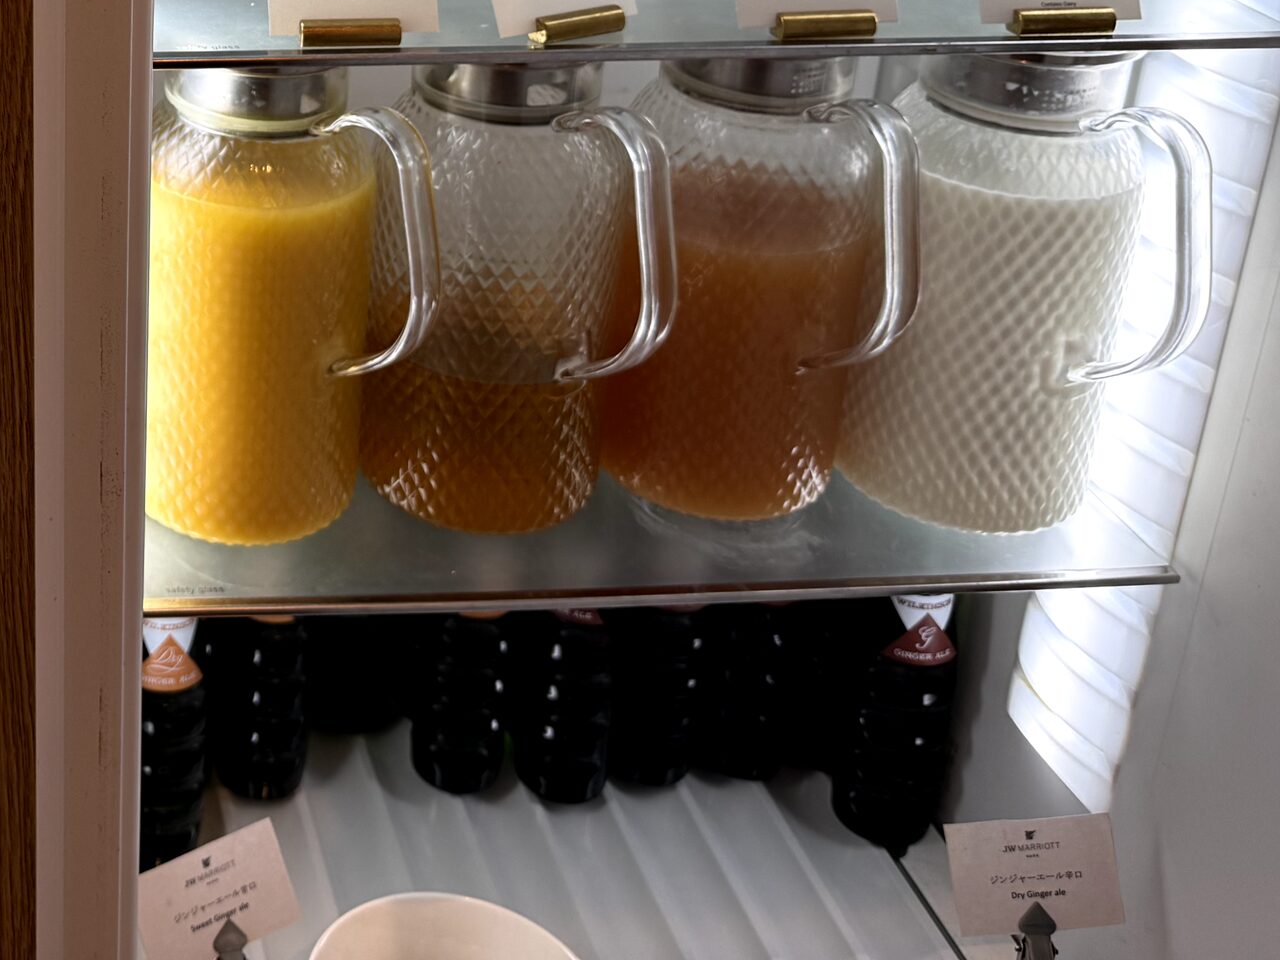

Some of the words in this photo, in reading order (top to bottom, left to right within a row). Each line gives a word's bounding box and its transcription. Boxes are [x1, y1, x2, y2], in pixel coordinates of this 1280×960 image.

[893, 647, 933, 660] GINGER
[1002, 845, 1017, 853] JW
[1017, 841, 1060, 852] MARRIOTT
[1011, 891, 1025, 900] Dry
[1026, 889, 1052, 900] Ginger
[1054, 888, 1066, 896] ale
